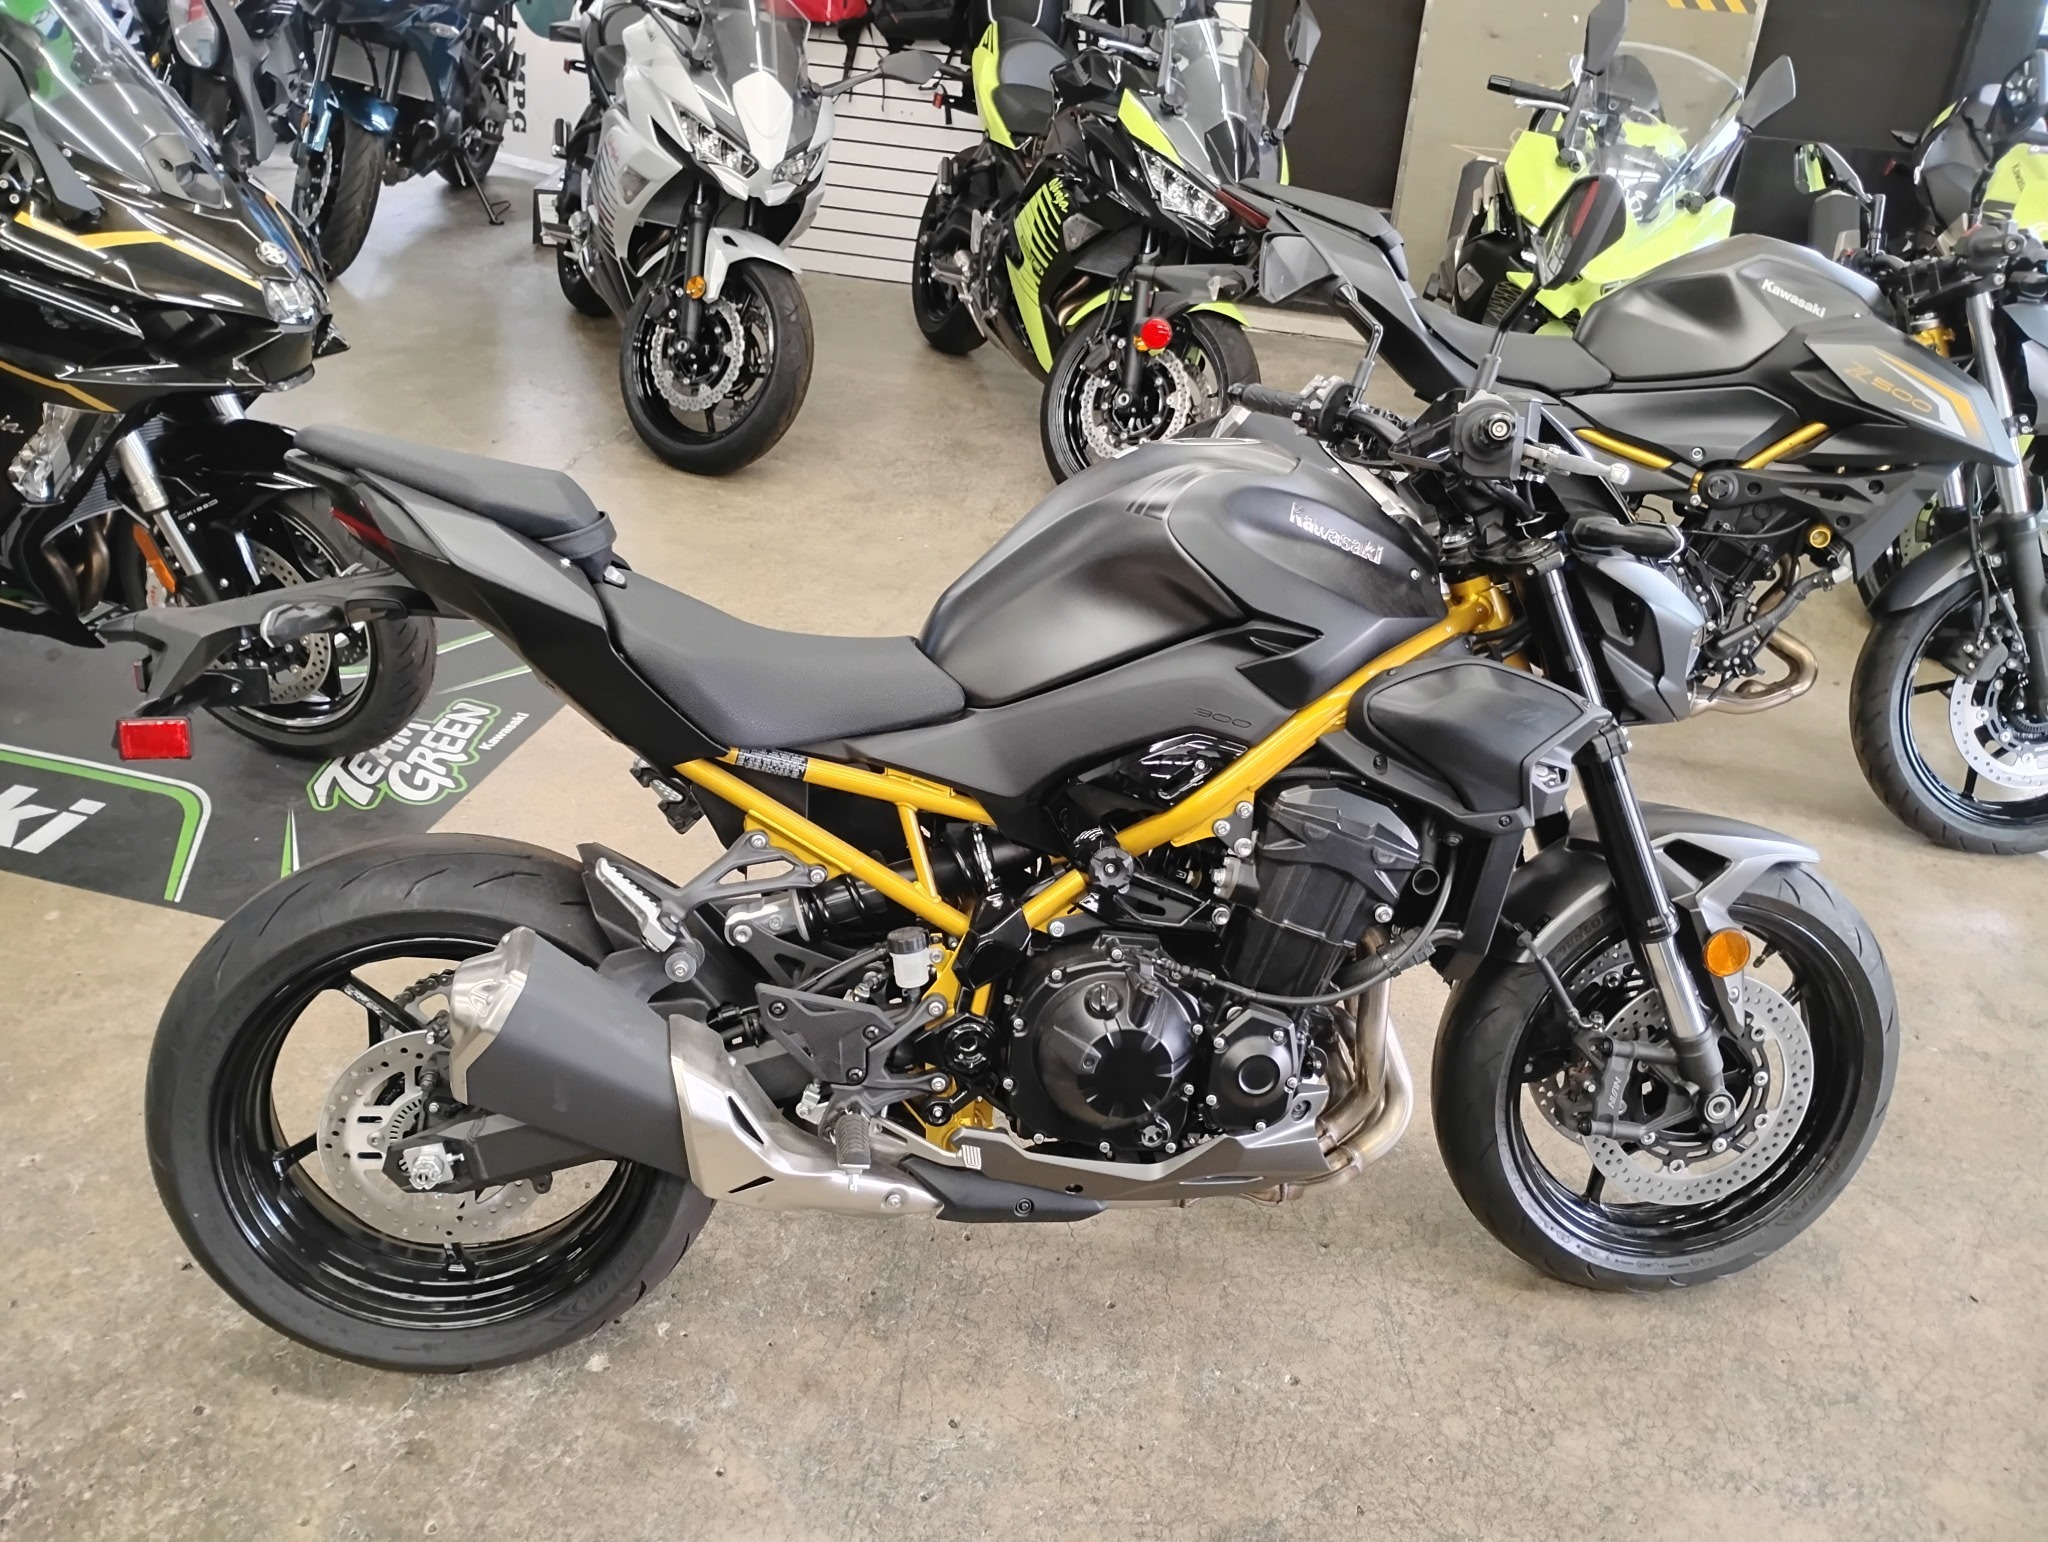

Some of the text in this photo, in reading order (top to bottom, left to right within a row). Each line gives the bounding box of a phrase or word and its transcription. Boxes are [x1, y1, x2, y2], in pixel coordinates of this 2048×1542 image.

[1048, 177, 1070, 213] Ninja
[1761, 278, 1826, 318] Kawasaki
[1288, 501, 1384, 565] Kawasaki
[388, 702, 491, 801] GREEN
[478, 711, 530, 750] Kawasaki
[313, 721, 431, 806] TEAM
